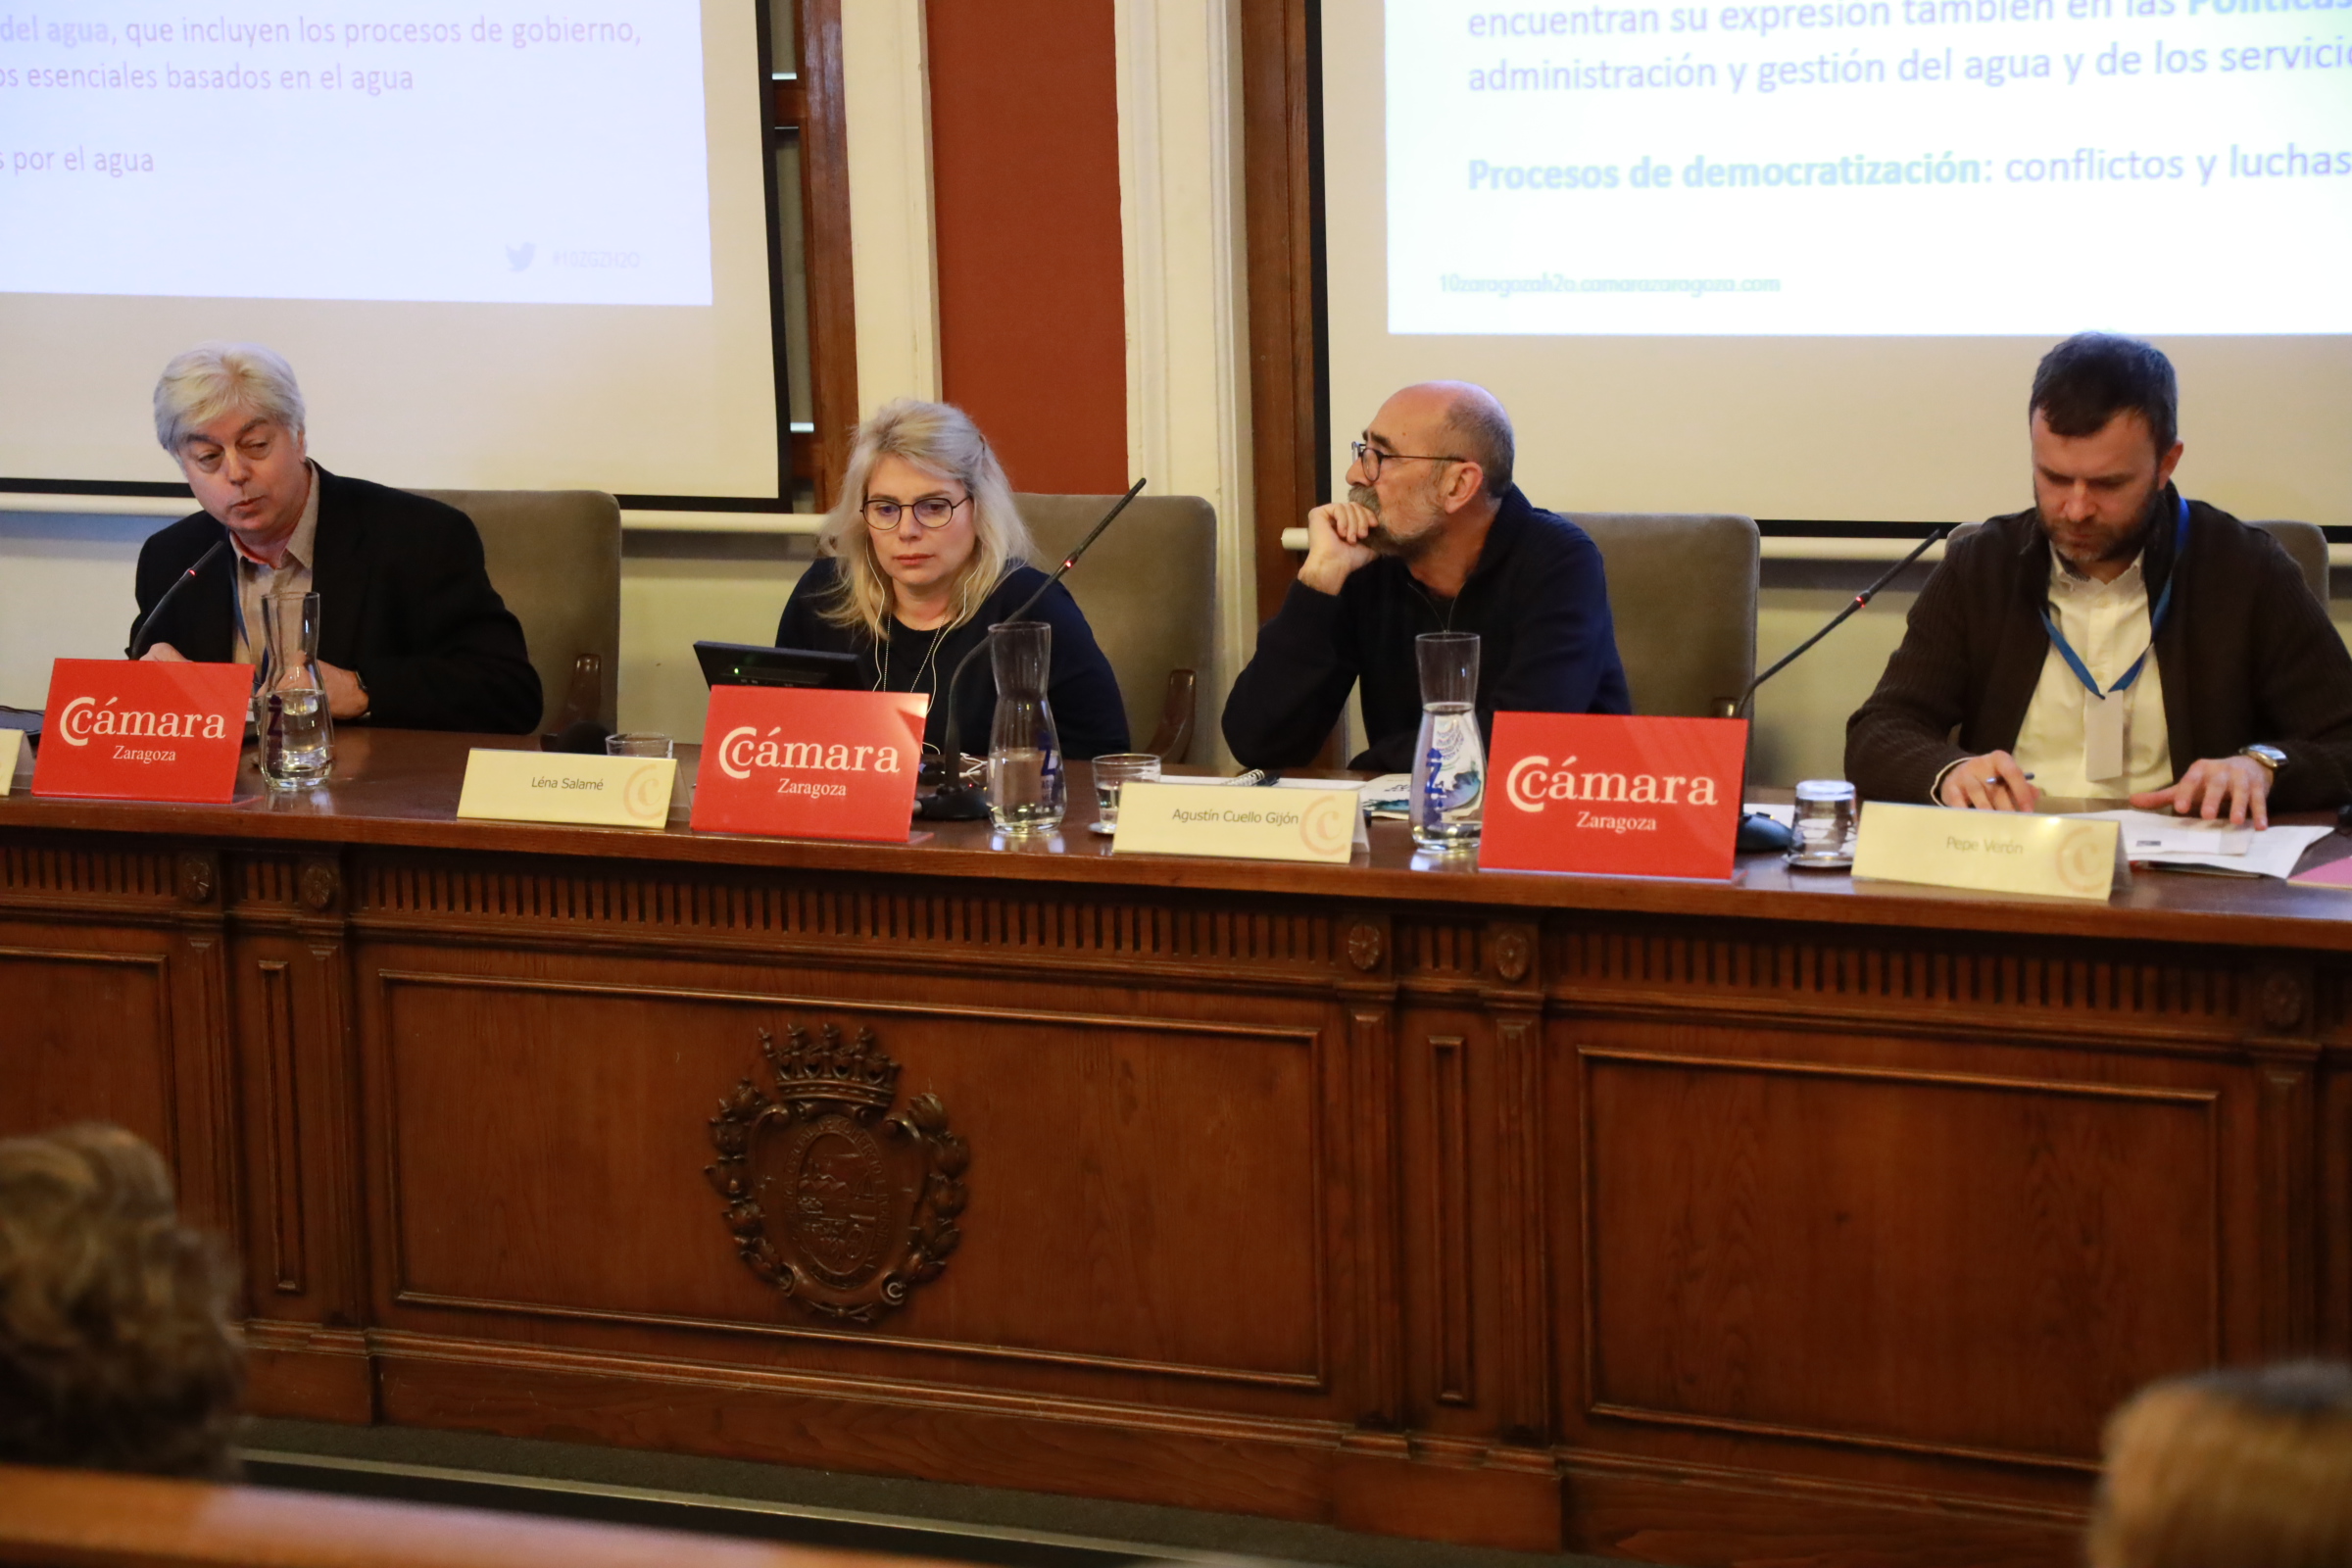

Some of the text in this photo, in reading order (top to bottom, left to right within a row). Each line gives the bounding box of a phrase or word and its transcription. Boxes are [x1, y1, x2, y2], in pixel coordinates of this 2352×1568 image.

[0, 14, 641, 50] del agua, que incluyen los procesos de gobierno,
[1468, 5, 1660, 37] encuentran
[1670, 8, 1707, 33] su
[2068, 0, 2112, 20] en
[27, 61, 157, 89] esenciales
[167, 62, 271, 90] basados
[280, 69, 312, 90] en
[319, 63, 342, 90] el
[352, 69, 414, 96] agua
[1468, 52, 1716, 91] administración
[1728, 62, 1749, 94] y
[1756, 47, 1884, 93] gestión
[1897, 47, 1951, 81] del
[1963, 53, 2051, 87] agua
[2063, 53, 2085, 85] y
[2095, 41, 2141, 75] de
[2154, 40, 2208, 74] los
[14, 151, 55, 176] por
[64, 144, 85, 172] el
[94, 152, 154, 178] agua
[1467, 142, 2352, 191] Procesos de democratización: conflictos y luchas
[112, 745, 177, 764] Zaragoza
[531, 776, 604, 791] Léna Salamé
[777, 777, 847, 799] Zaragoza
[1172, 808, 1299, 827] Agustín Cuello Gijón
[1576, 810, 1657, 834] Zaragoza
[1946, 836, 1980, 853] Pepe
